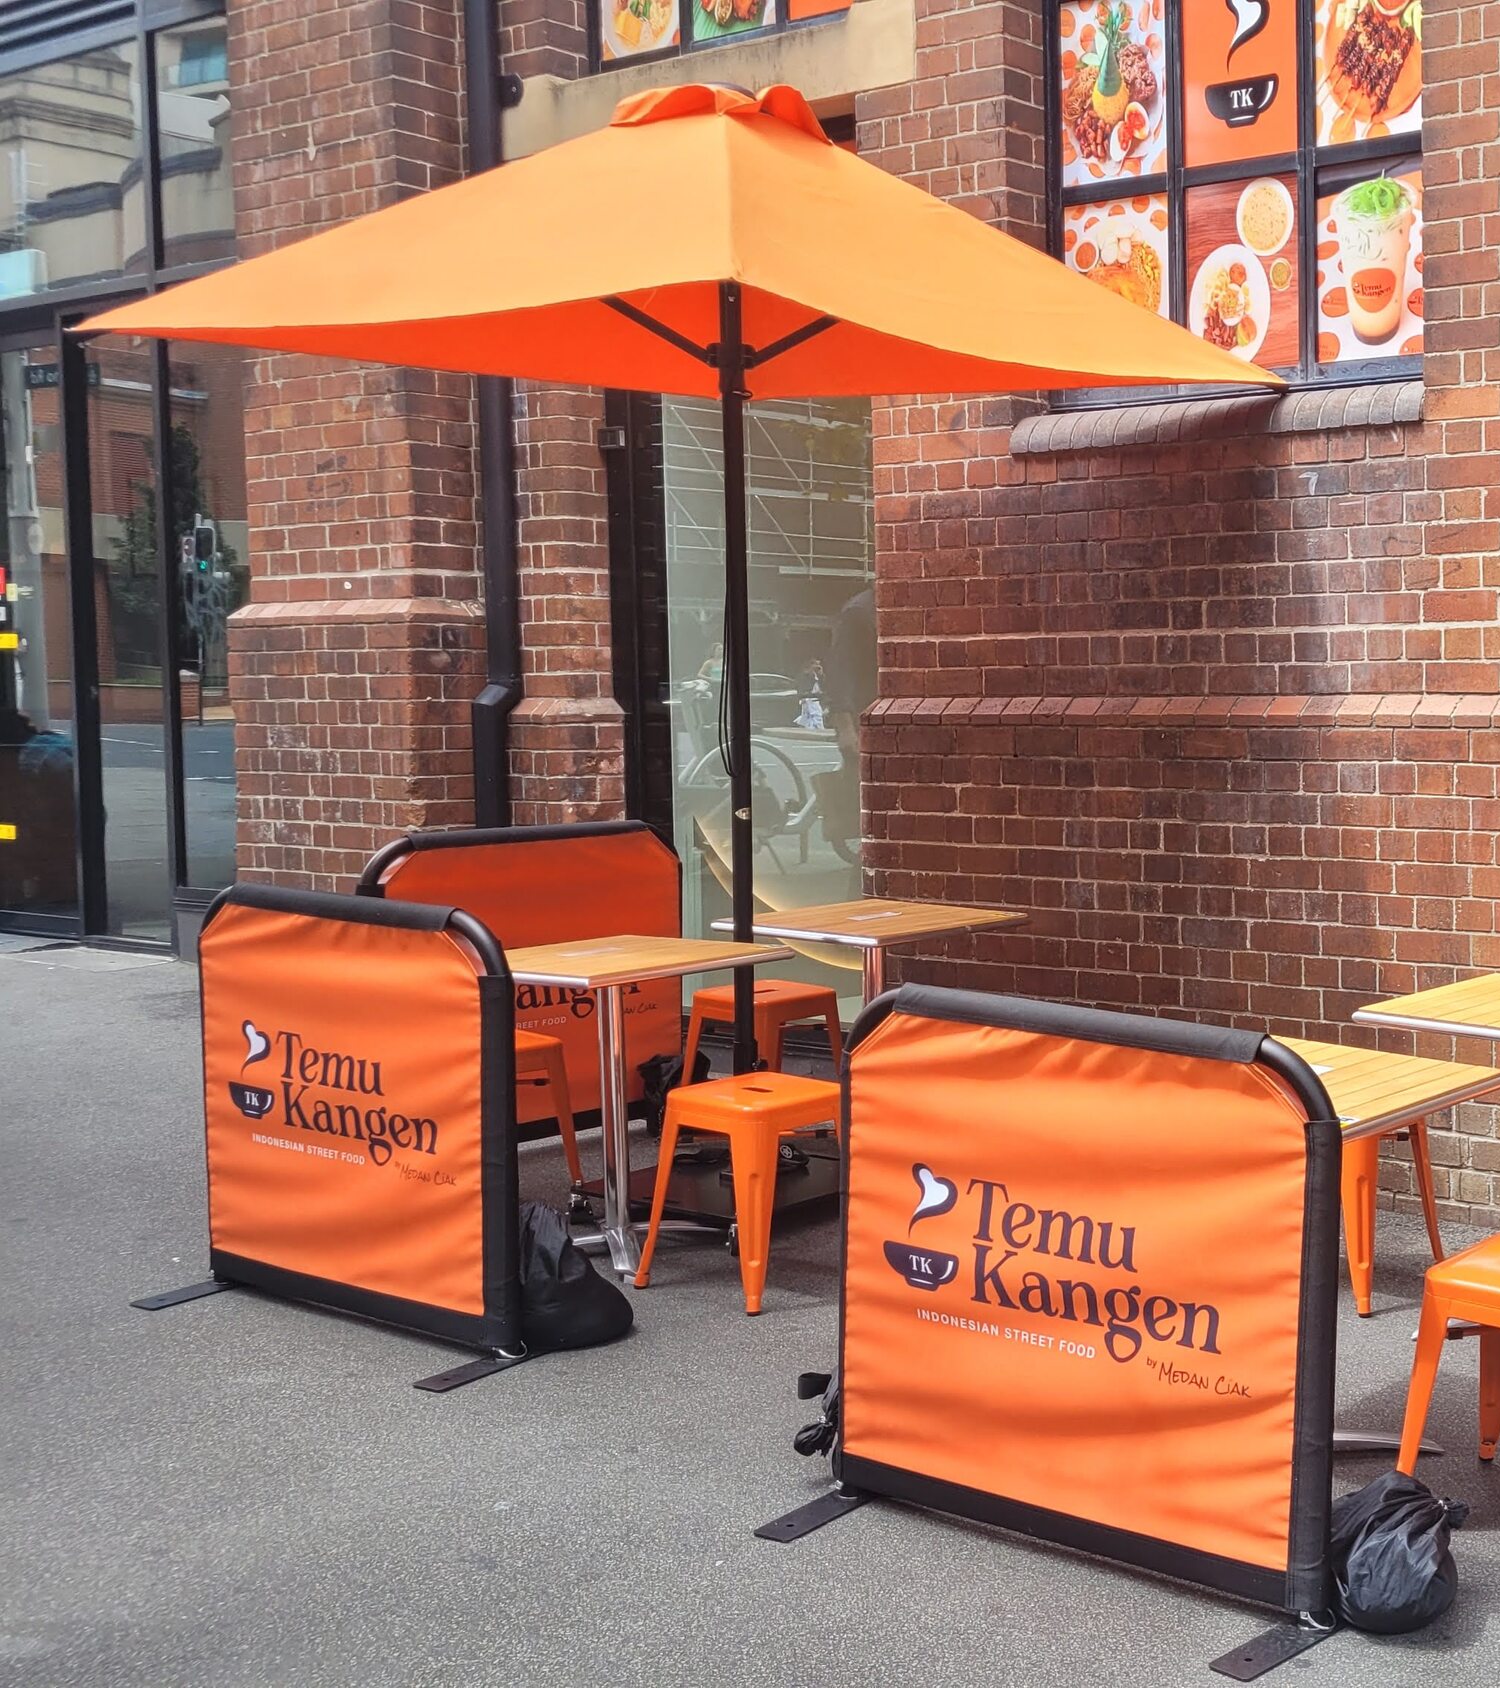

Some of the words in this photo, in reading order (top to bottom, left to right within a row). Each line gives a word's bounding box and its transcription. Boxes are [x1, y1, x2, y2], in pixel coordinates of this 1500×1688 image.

[1230, 88, 1254, 109] TK
[542, 1016, 567, 1026] FOOD
[276, 1030, 385, 1097] Temu
[244, 1091, 261, 1106] TK
[281, 1080, 439, 1166] Kangen
[252, 1133, 305, 1153] INDONESIAN
[306, 1145, 339, 1160] STREET
[341, 1152, 365, 1165] FOOD
[966, 1178, 1138, 1273] Temu
[908, 1254, 934, 1275] TK
[970, 1242, 1222, 1364] Kangen
[916, 1308, 999, 1337] INDONESIAN
[1004, 1327, 1055, 1350] STREET
[1059, 1340, 1096, 1360] FOOD
[1146, 1356, 1157, 1370] by
[1158, 1362, 1210, 1390] MEDAN
